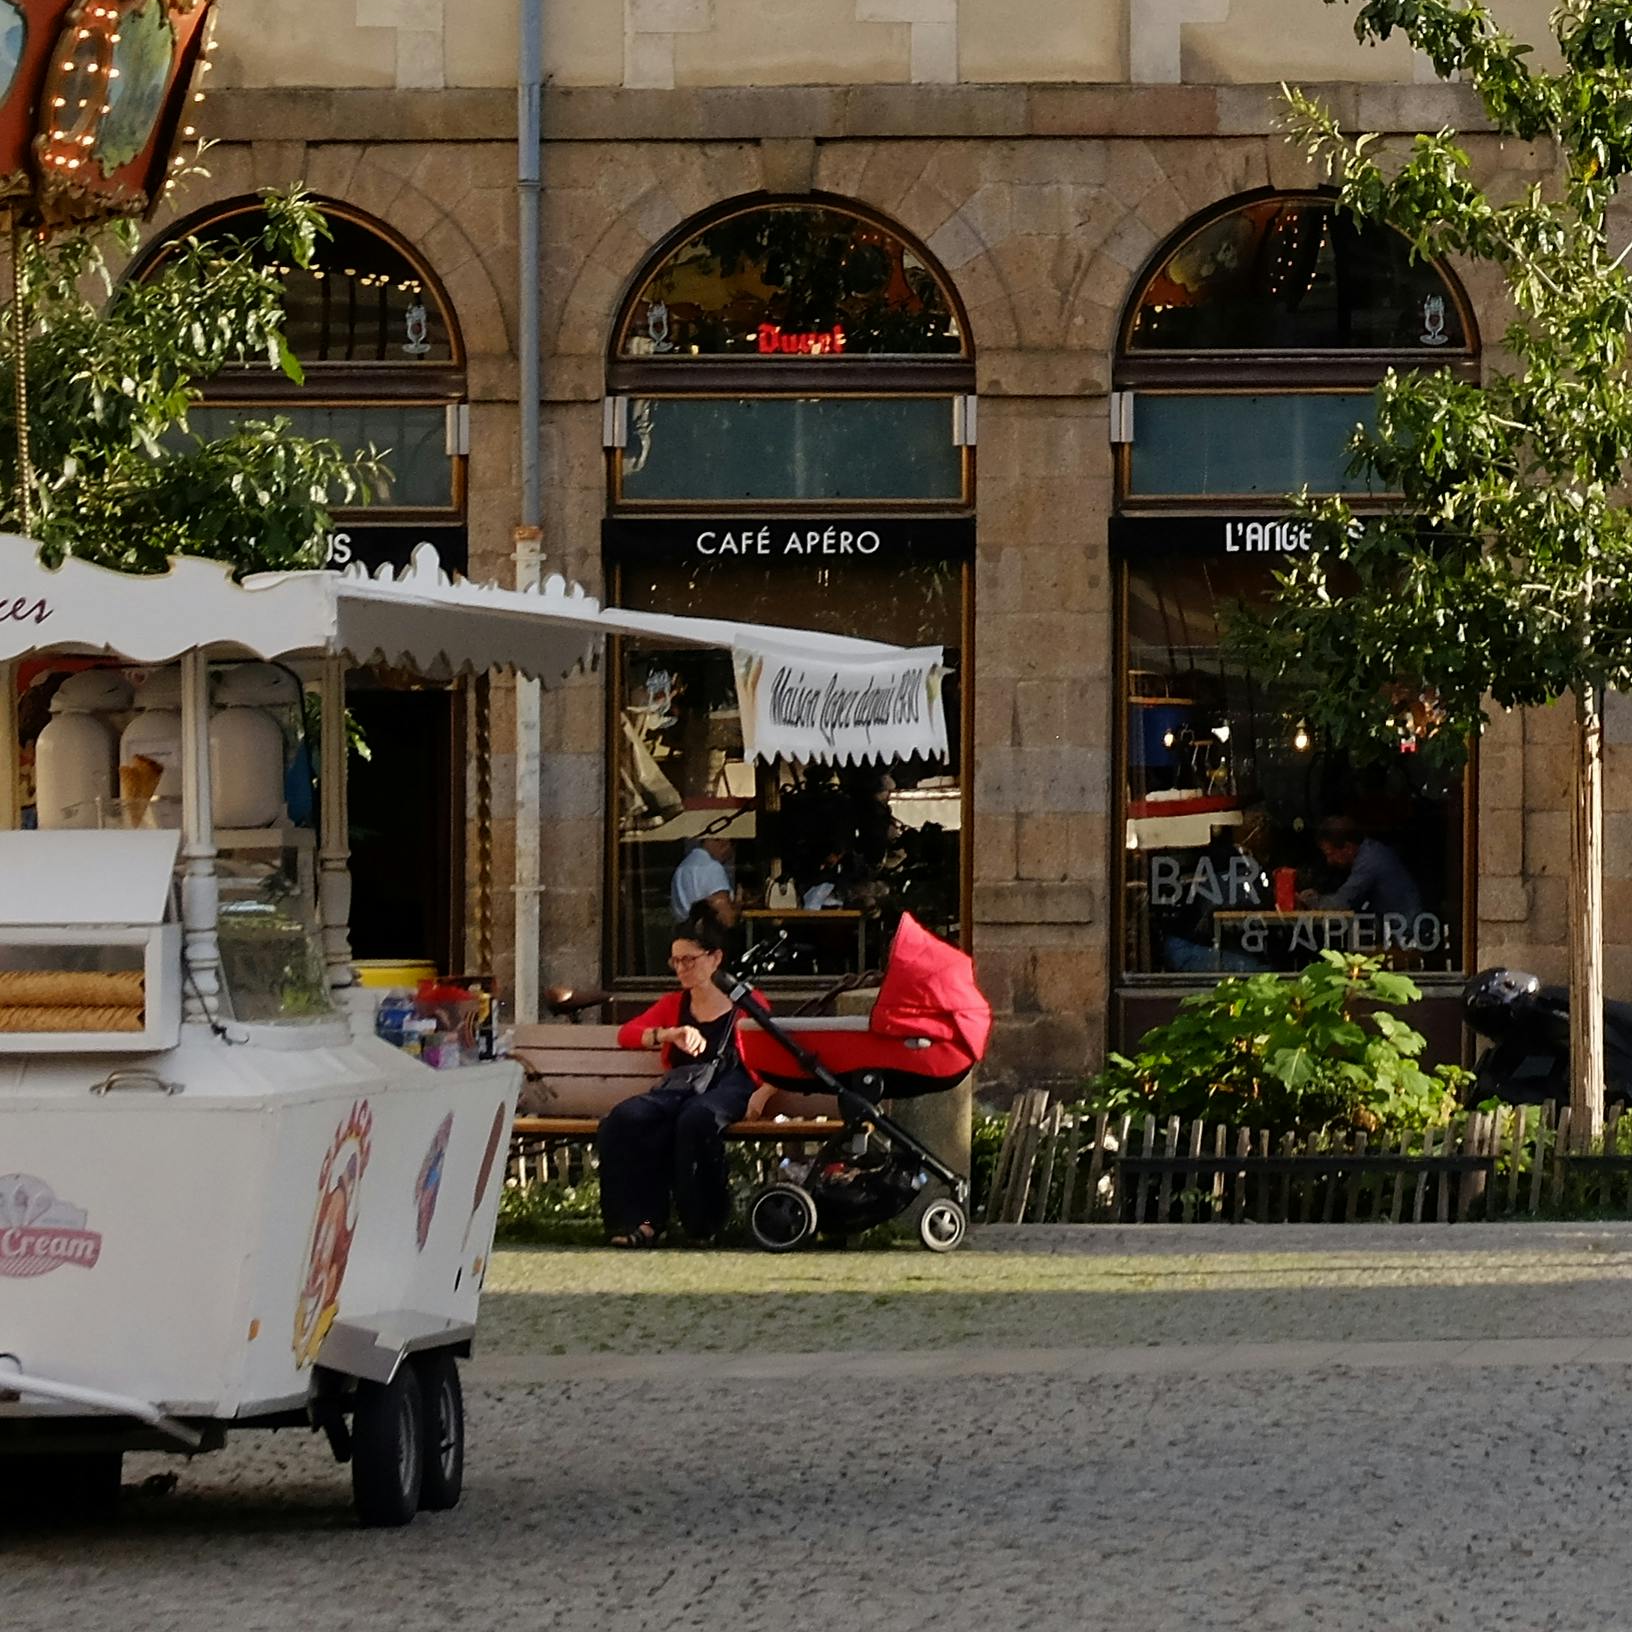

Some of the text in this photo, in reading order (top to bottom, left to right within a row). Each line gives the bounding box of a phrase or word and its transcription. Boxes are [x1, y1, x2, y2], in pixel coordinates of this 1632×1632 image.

[696, 525, 881, 555] CAFÉ APÉRO
[1151, 856, 1262, 906] BAR
[1240, 913, 1270, 953] &
[2, 1228, 95, 1260] Cream
